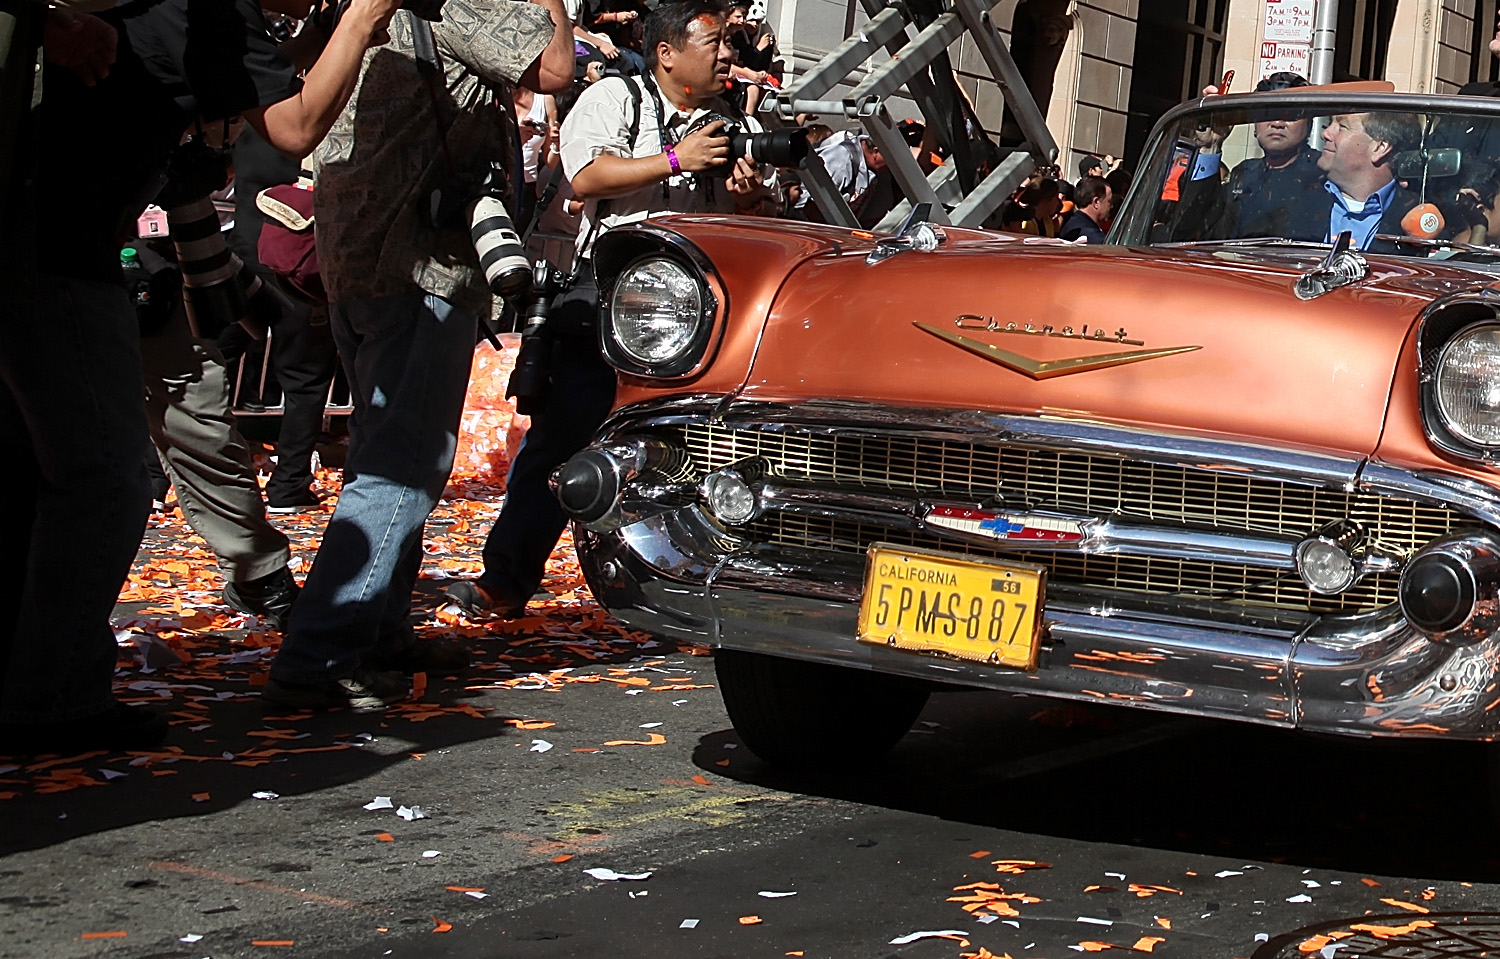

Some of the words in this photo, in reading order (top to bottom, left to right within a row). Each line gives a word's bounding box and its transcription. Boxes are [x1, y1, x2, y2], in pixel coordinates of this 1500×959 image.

[1262, 43, 1275, 58] NO
[1277, 47, 1307, 60] PARKING
[954, 314, 1136, 344] Chevrolet
[879, 563, 958, 587] CALIFORNIA
[1003, 581, 1017, 593] 56
[875, 584, 1028, 646] 5PMS887
